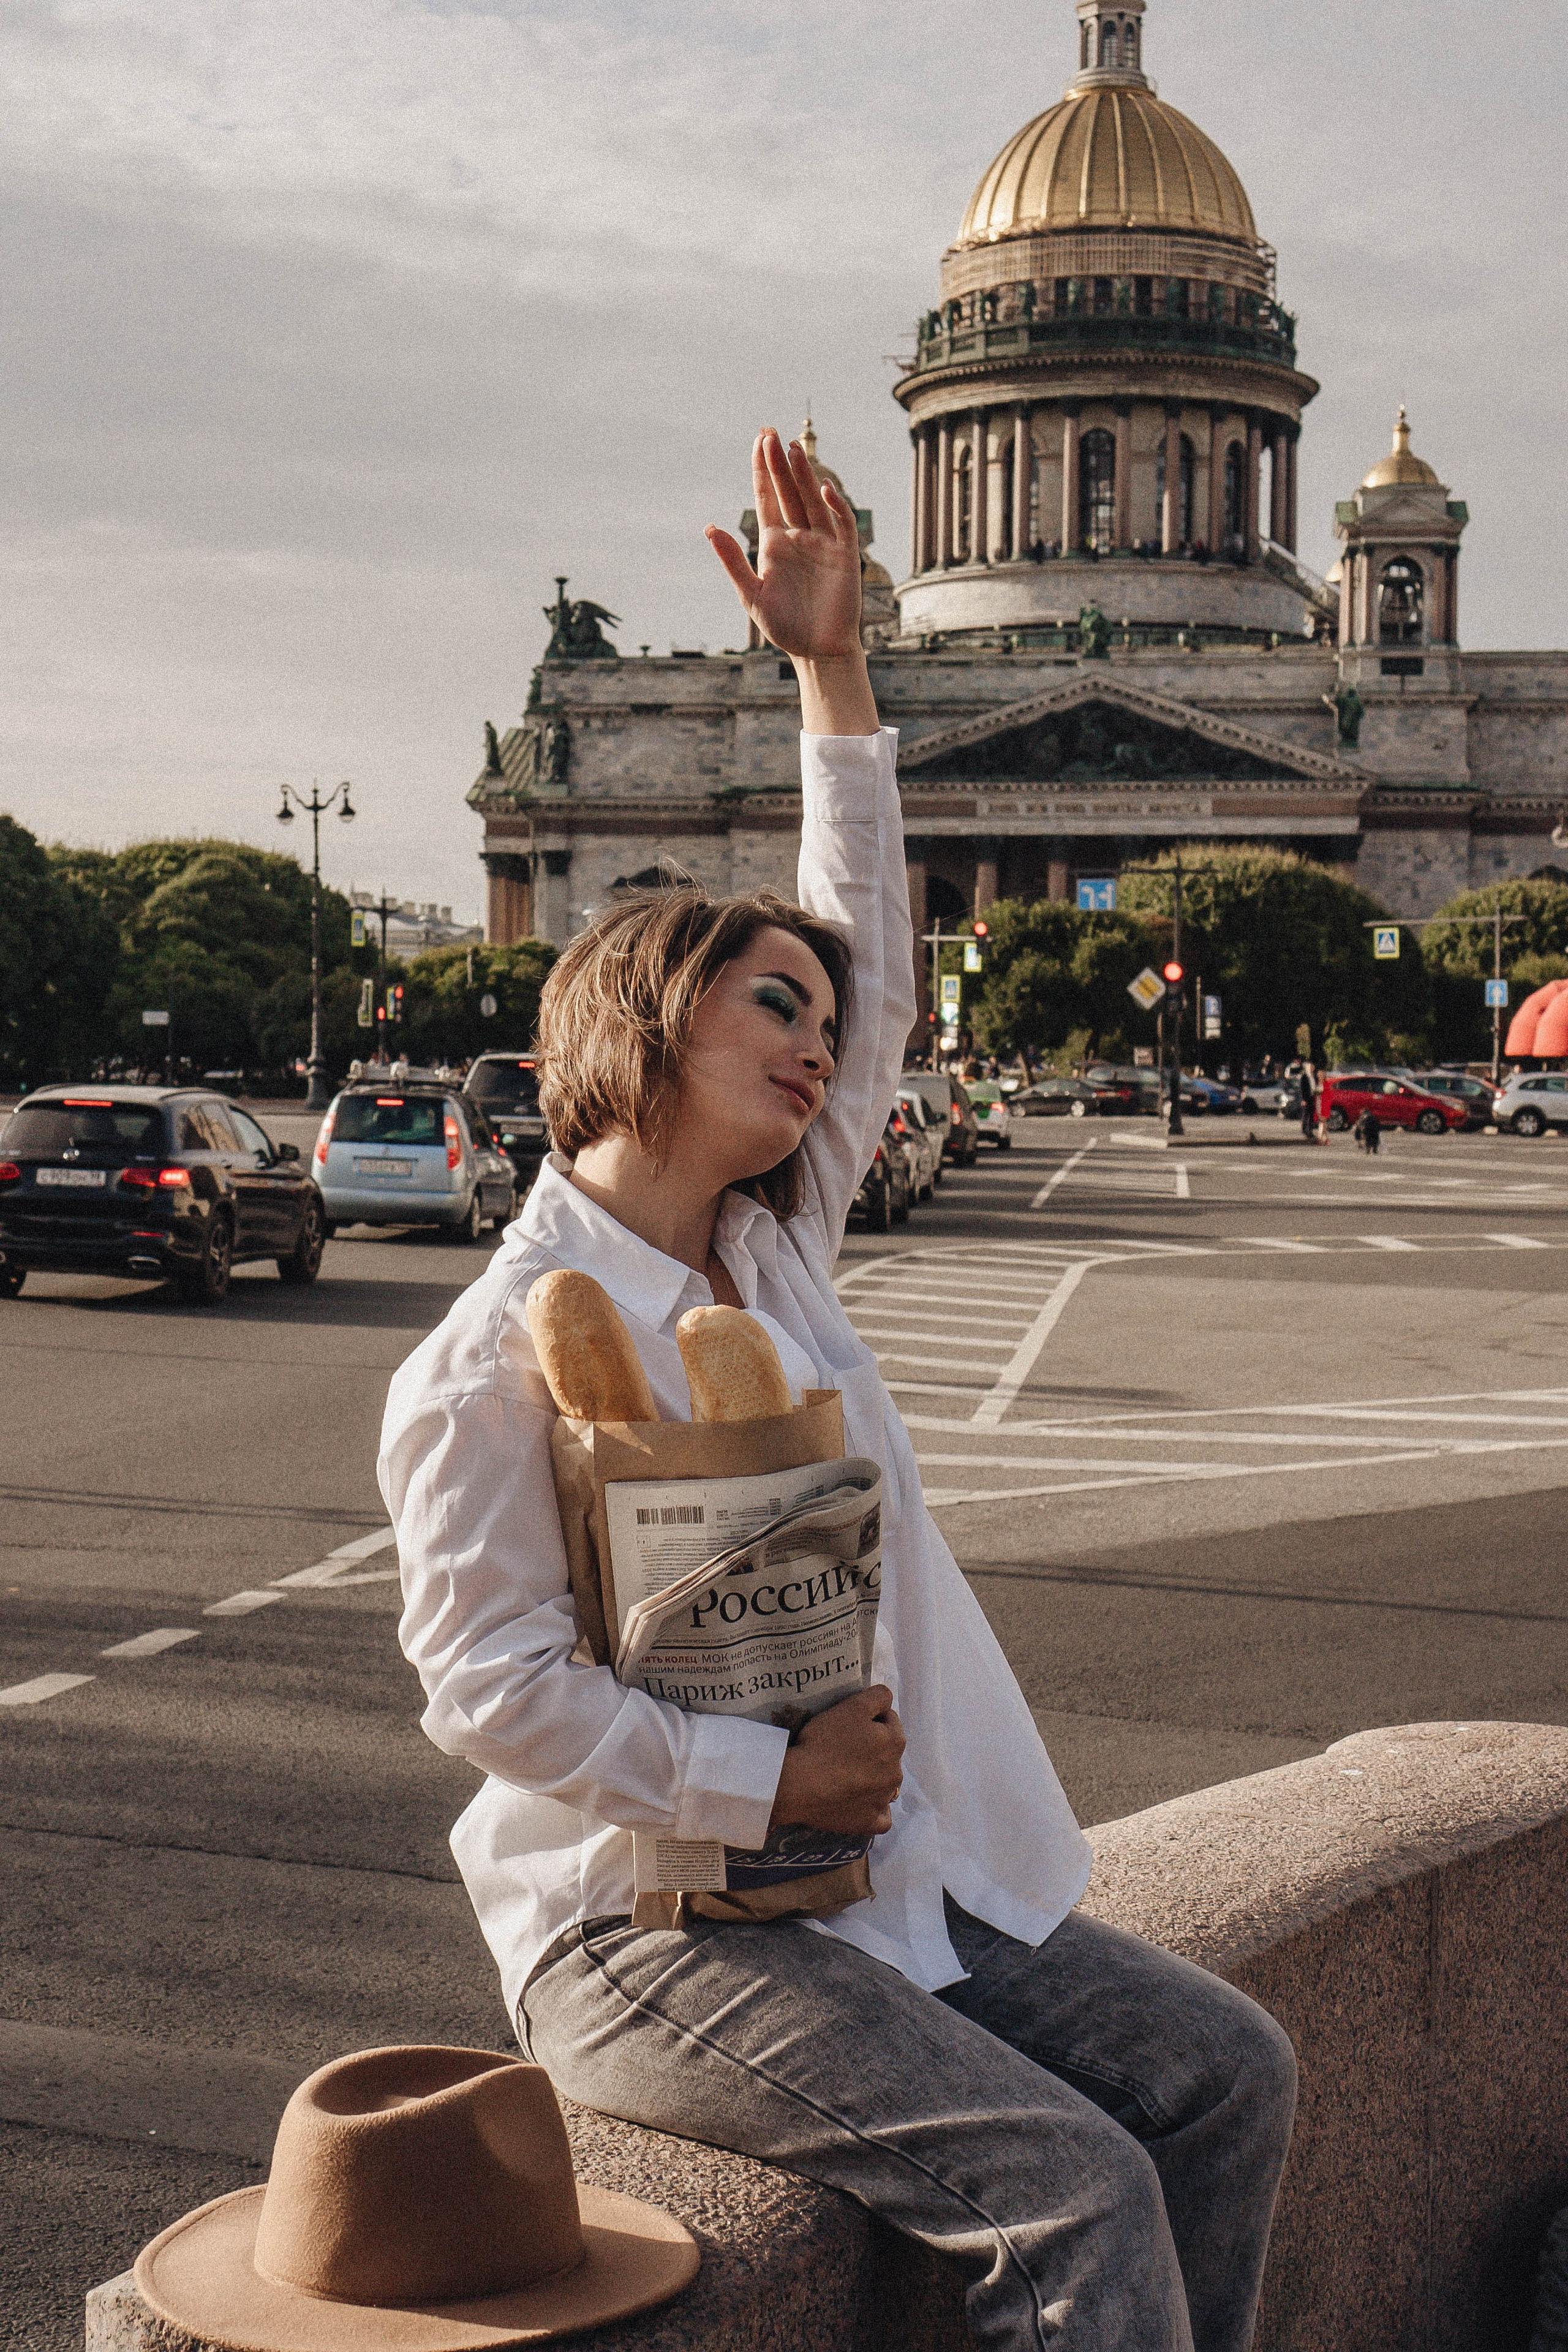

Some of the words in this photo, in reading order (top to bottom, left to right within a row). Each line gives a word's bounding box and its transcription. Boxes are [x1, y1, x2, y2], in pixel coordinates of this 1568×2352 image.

[665, 1656, 698, 1664] КОЛЕЦ
[702, 1653, 729, 1664] МОК
[731, 1651, 742, 1660] не
[744, 1641, 797, 1657] допускает
[800, 1628, 839, 1649] россиян
[841, 1622, 851, 1632] на
[677, 1665, 731, 1675] надеждам
[733, 1654, 772, 1671] попасть
[774, 1653, 787, 1661] на
[643, 1677, 745, 1706] Париж
[748, 1656, 859, 1694] закрыт...
[840, 1849, 861, 1859] 26
